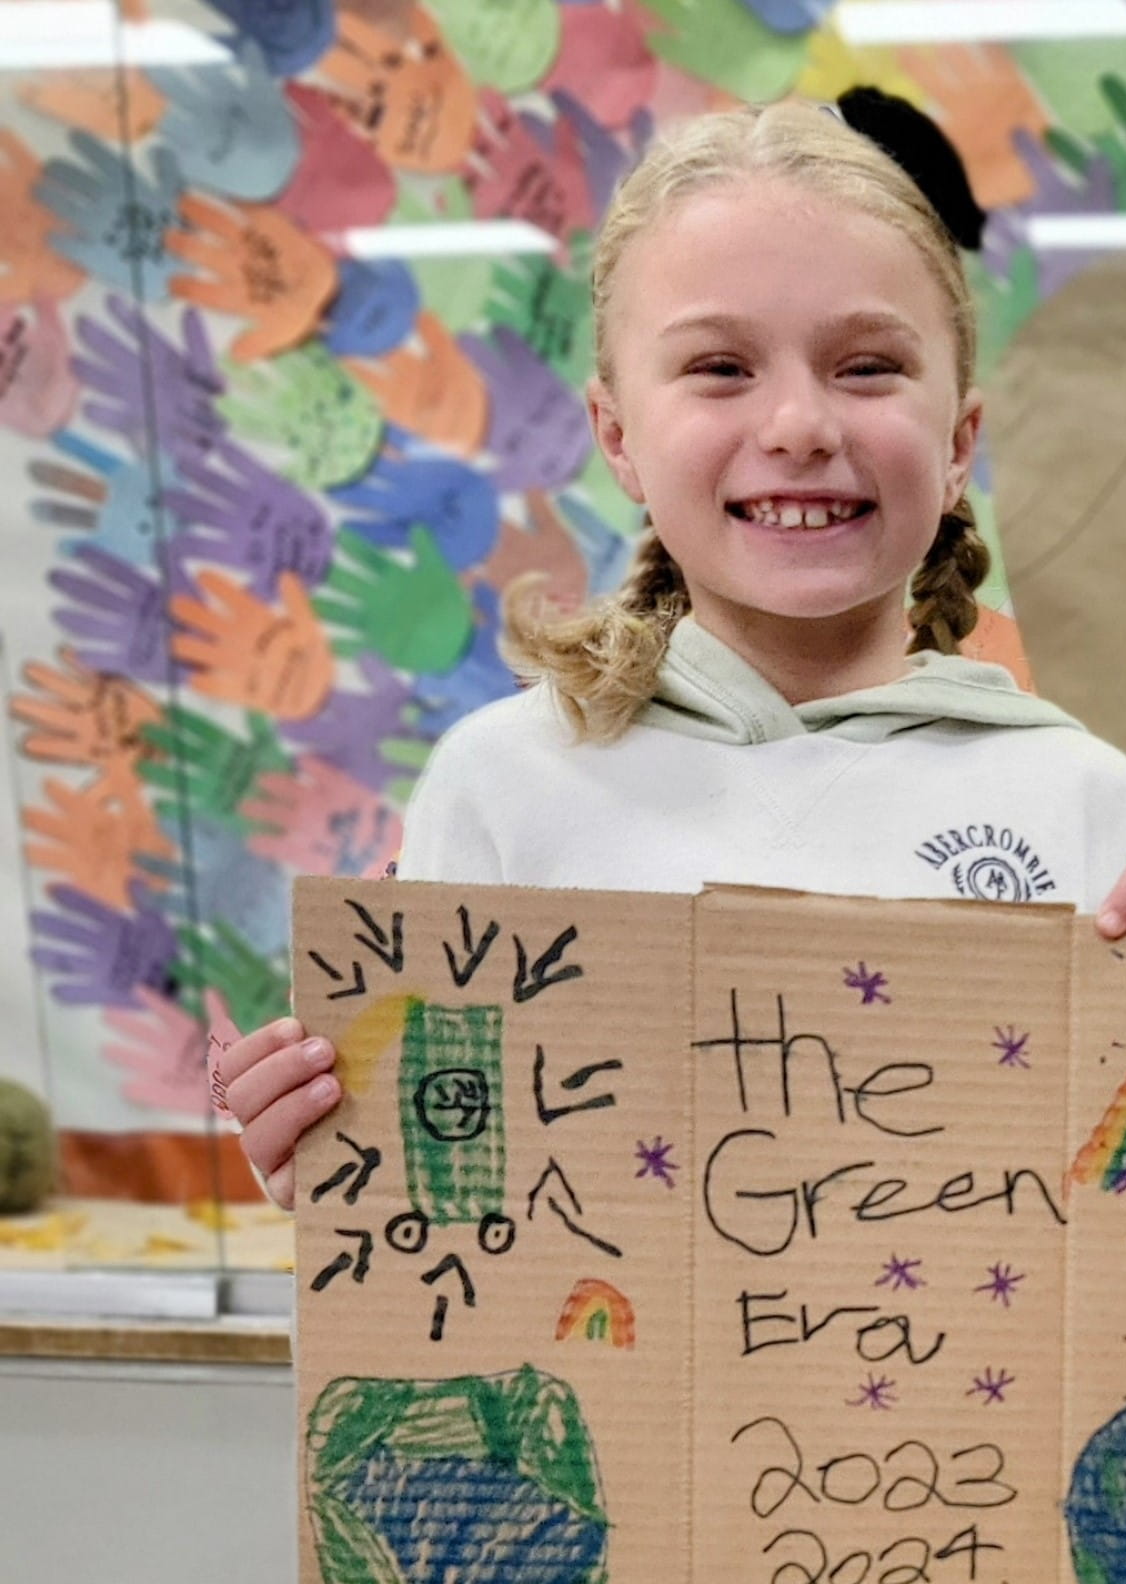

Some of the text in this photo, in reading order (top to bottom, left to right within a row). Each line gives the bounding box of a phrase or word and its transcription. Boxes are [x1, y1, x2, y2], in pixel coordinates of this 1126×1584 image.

[690, 988, 948, 1139] the
[703, 1128, 1070, 1258] Green
[736, 1289, 948, 1367] Era
[731, 1416, 1020, 1520] 2023
